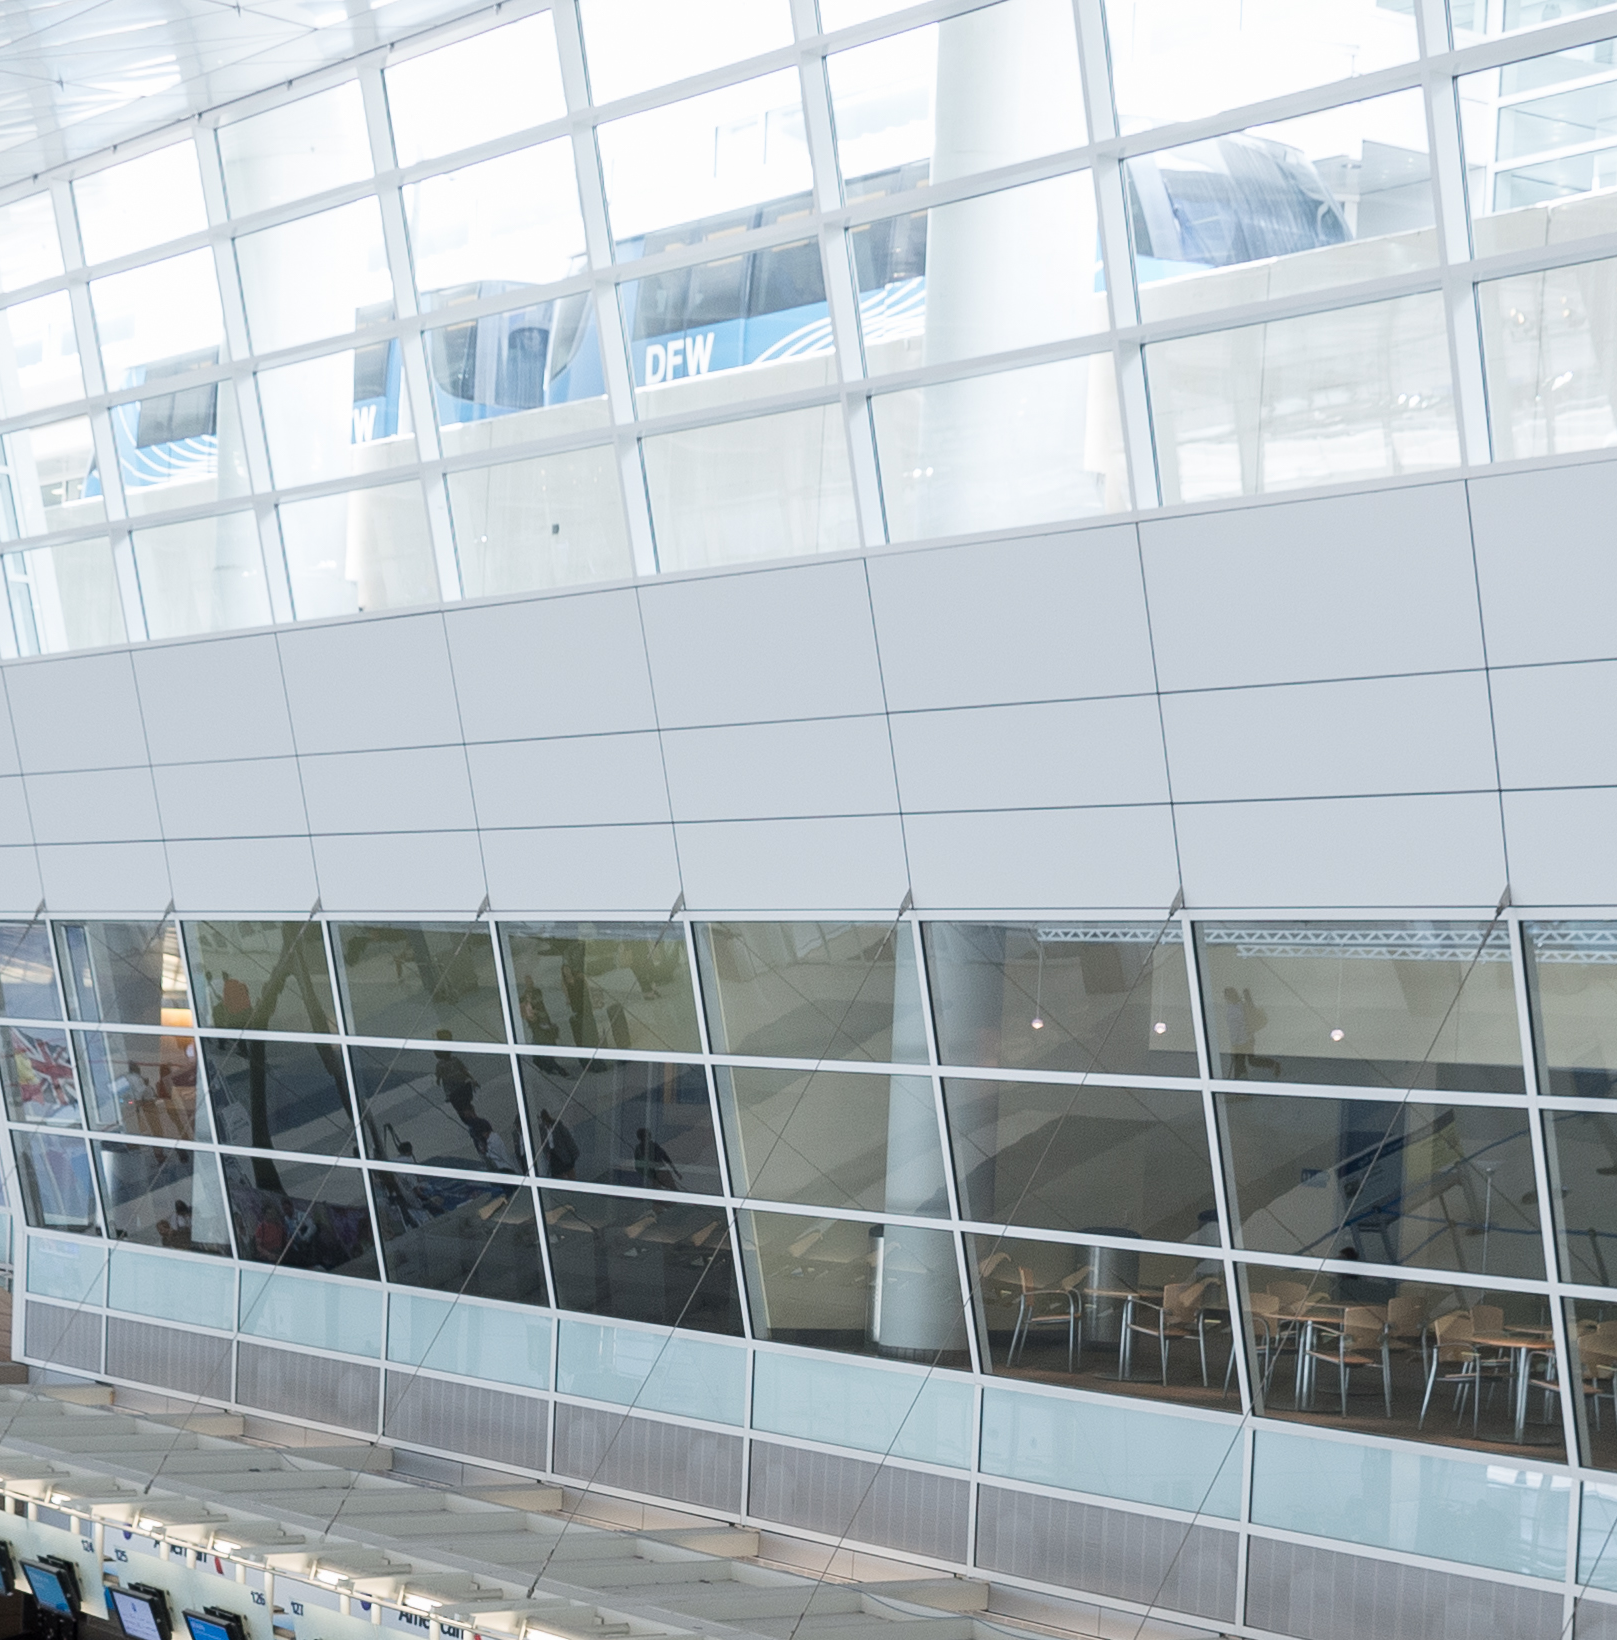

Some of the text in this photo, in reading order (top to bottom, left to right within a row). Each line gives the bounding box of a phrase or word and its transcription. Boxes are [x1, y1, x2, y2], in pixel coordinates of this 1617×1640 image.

[645, 332, 715, 385] DFW
[81, 1540, 95, 1554] 124
[114, 1548, 128, 1562] 125
[250, 1591, 266, 1606] 126
[291, 1601, 304, 1616] 127
